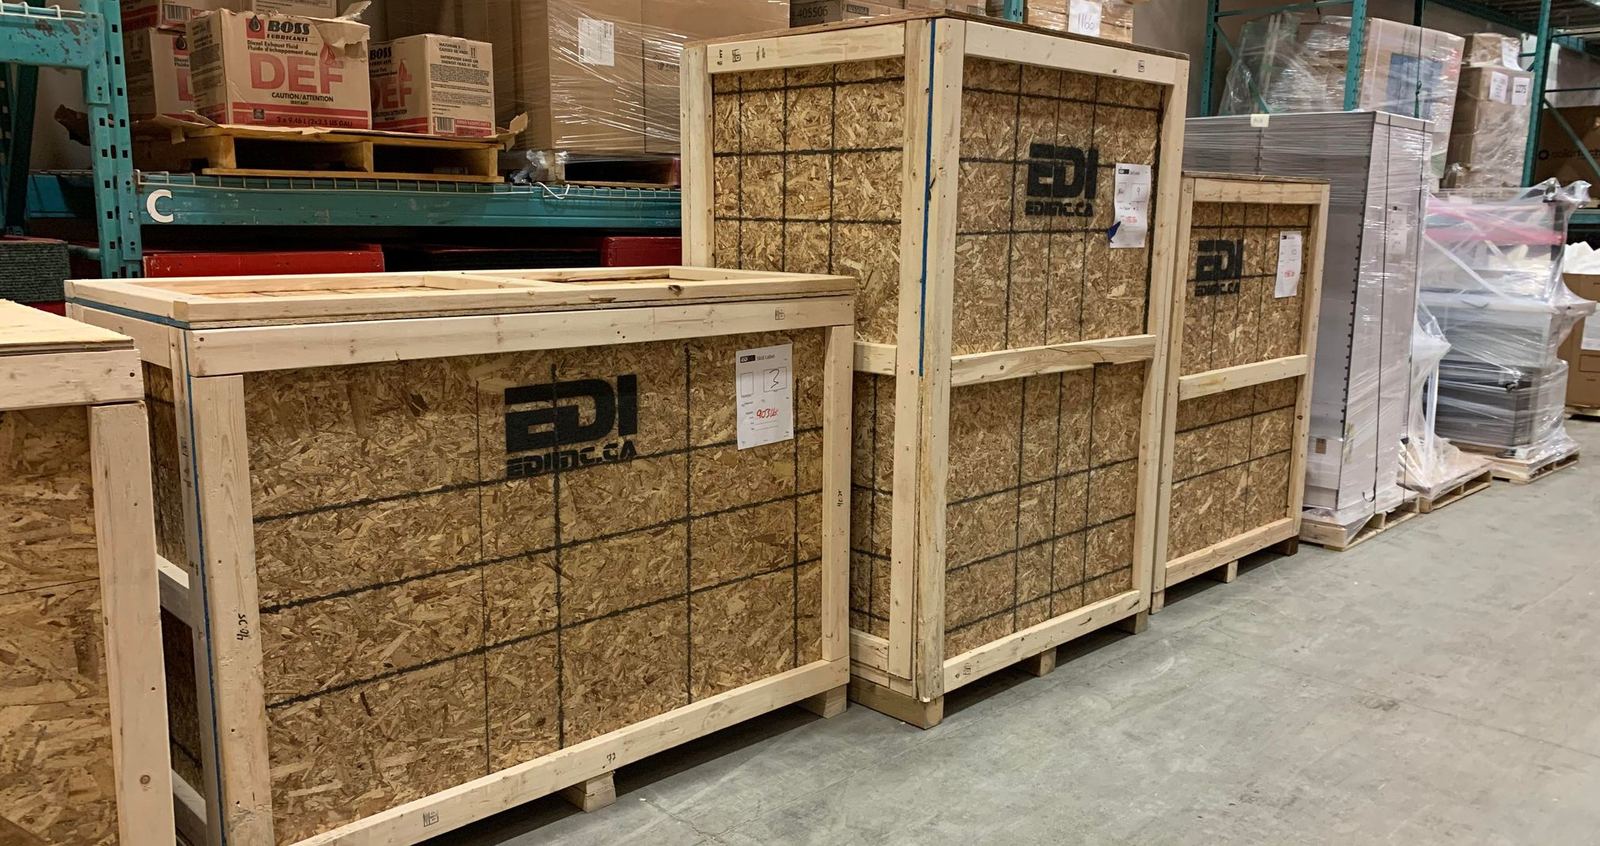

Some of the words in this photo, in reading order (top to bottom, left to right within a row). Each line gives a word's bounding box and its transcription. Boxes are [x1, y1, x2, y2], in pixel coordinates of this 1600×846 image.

[267, 34, 308, 42] LUBRICANTS
[268, 20, 310, 35] BOSS
[370, 47, 392, 60] BOSS
[250, 52, 344, 95] DEF
[272, 92, 334, 102] CAUTION/ATTENTION
[1026, 143, 1098, 200] EDI
[147, 189, 174, 222] C
[1196, 239, 1244, 280] EDI
[505, 374, 638, 454] EDI
